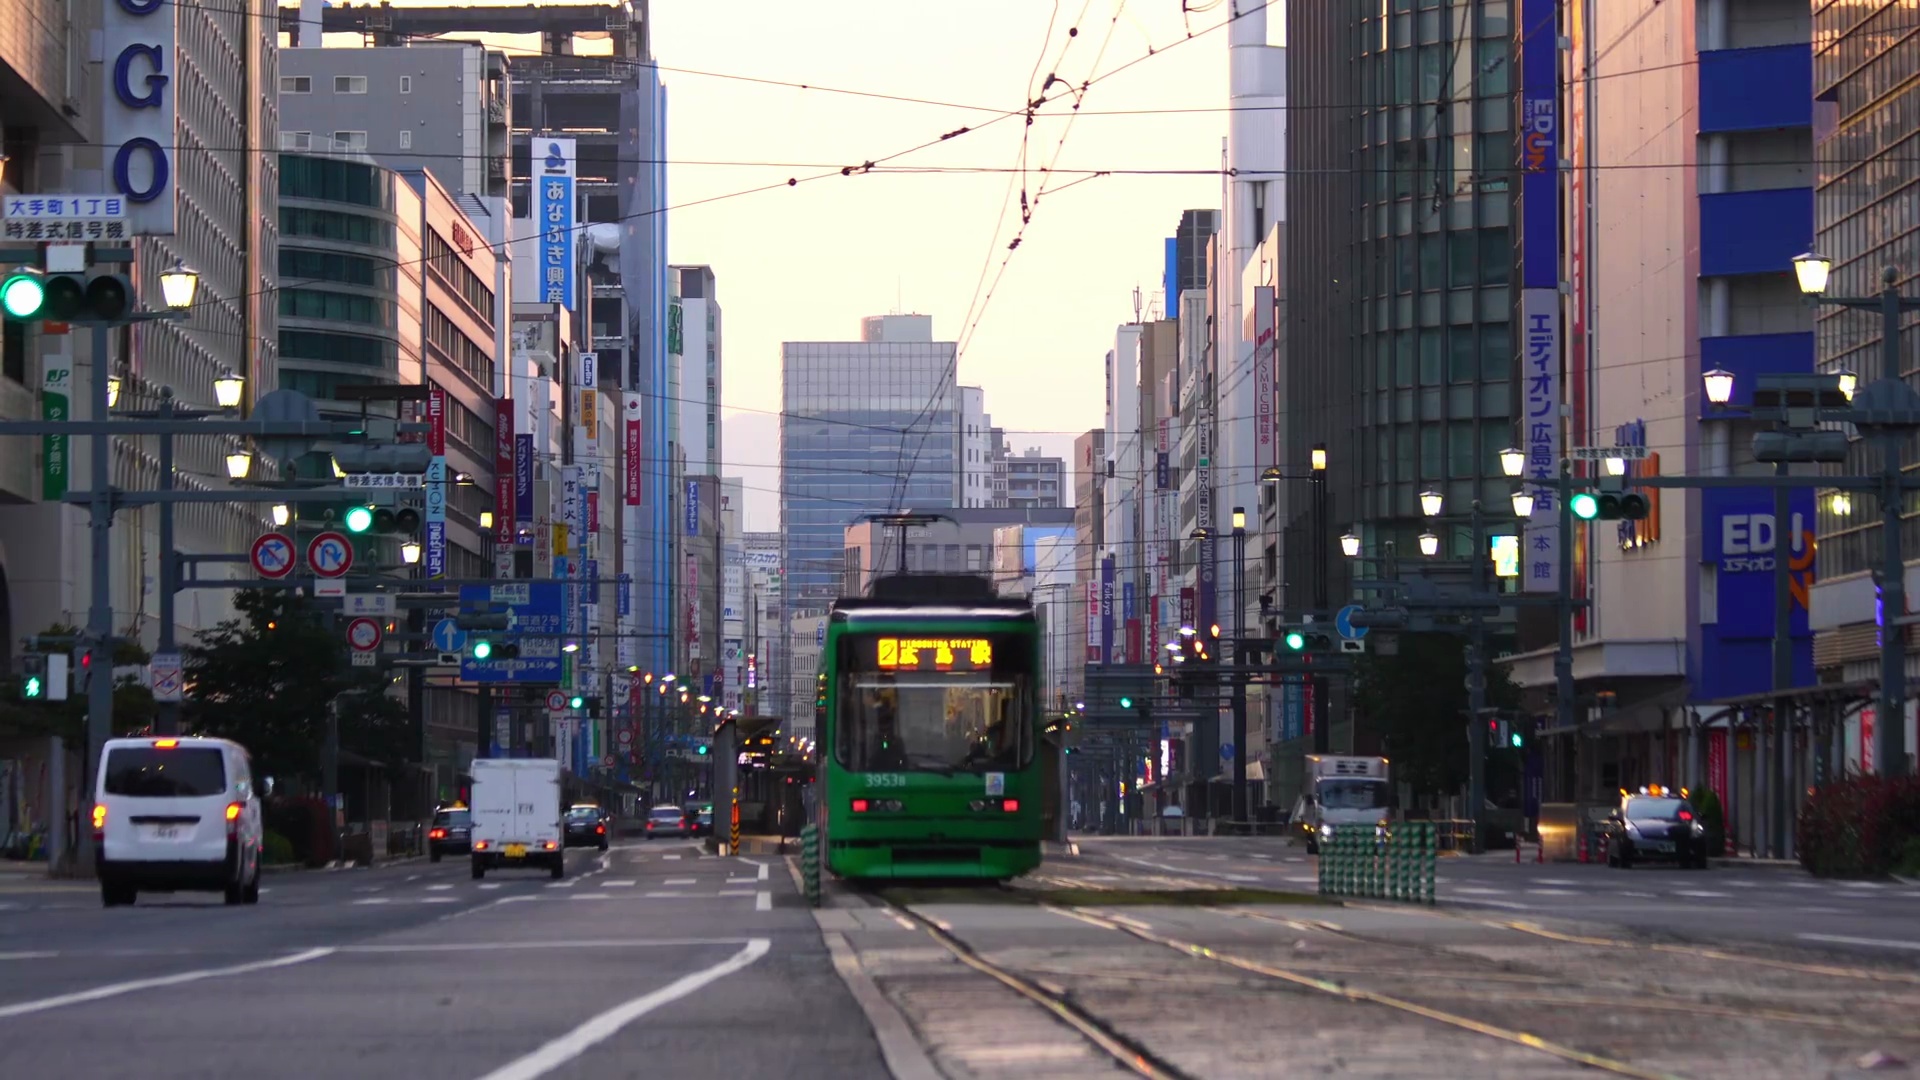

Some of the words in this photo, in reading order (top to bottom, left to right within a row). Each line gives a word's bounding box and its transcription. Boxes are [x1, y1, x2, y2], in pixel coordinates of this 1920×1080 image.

[113, 0, 169, 203] GO
[4, 221, 125, 240] 時差式信号機
[546, 181, 565, 303] あなぶき興産
[430, 392, 441, 416] LEC
[1259, 362, 1271, 445] SMBC日興証券
[49, 407, 62, 475] ゆちょ銀行
[348, 476, 418, 487] 時差式信号機
[431, 462, 442, 515] KUMON
[518, 438, 526, 497] アパマンショップ
[500, 517, 509, 542] TAC
[537, 515, 548, 562] 大和証券
[1533, 534, 1550, 579] 本館
[1090, 590, 1098, 616] LABI
